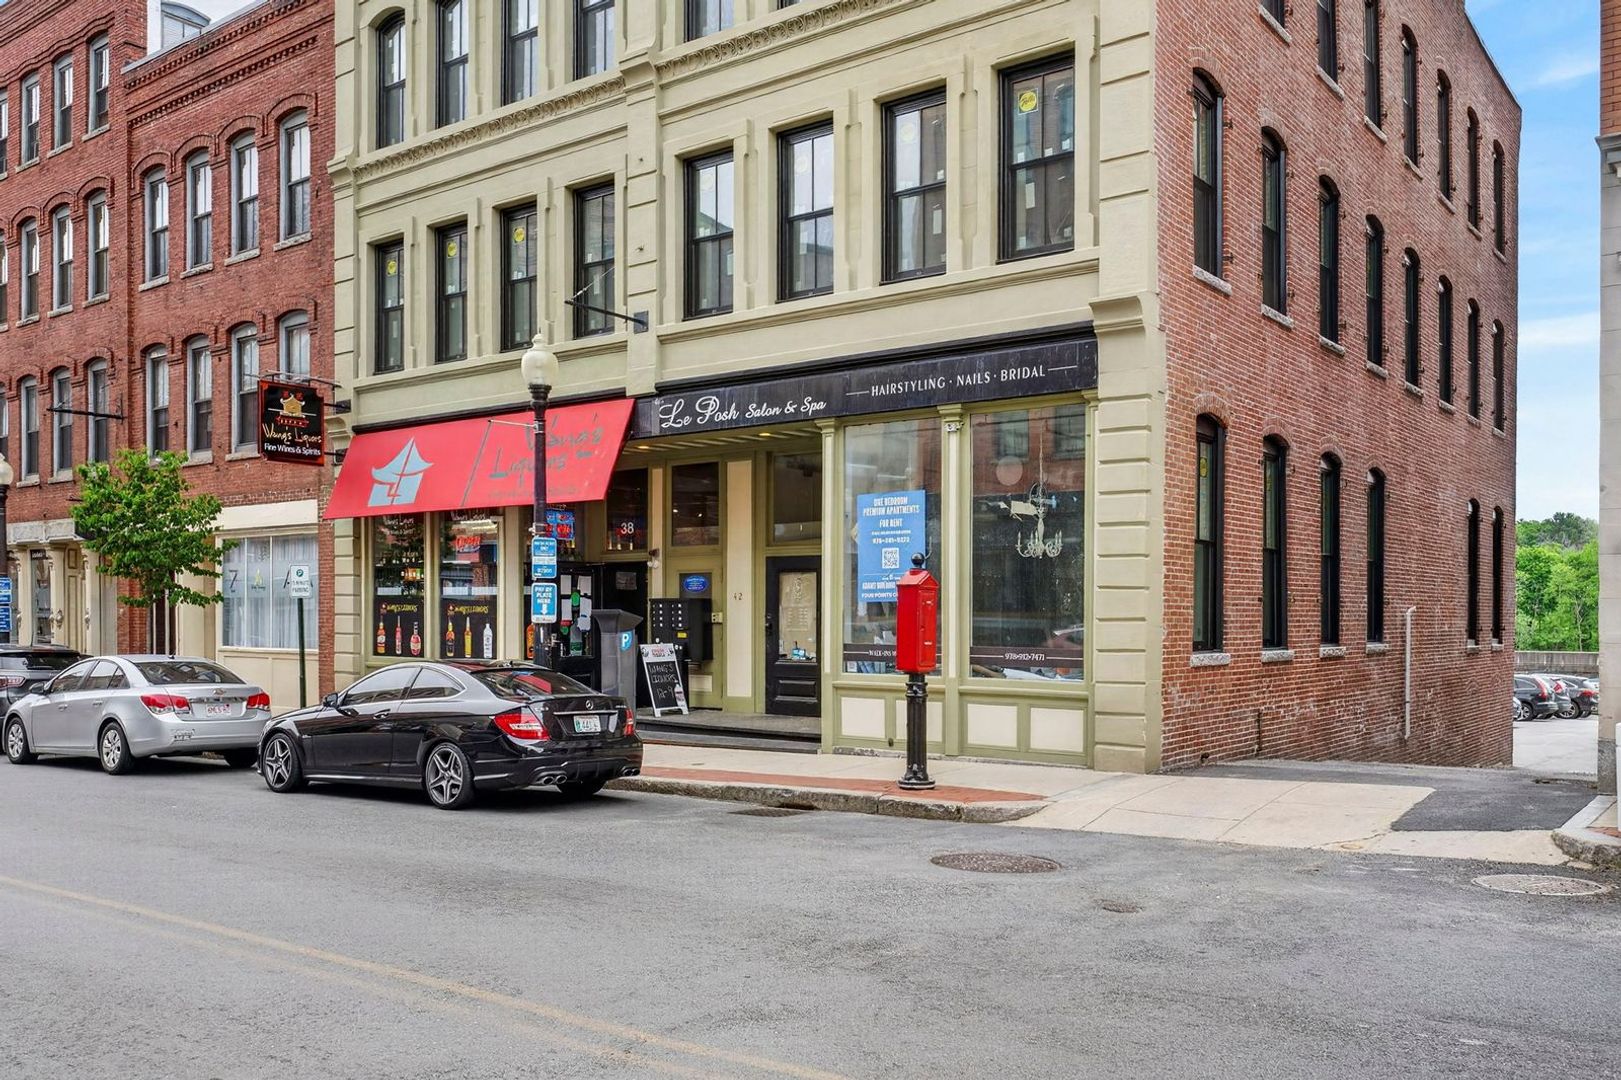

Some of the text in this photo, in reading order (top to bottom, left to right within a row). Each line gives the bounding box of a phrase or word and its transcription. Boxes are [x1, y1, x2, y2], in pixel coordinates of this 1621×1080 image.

[871, 365, 1046, 397] HAIRSTYLING NAILS BRIDAL
[659, 395, 827, 428] Le Posh Salon & Spa
[294, 427, 322, 448] Liquors
[488, 447, 567, 488] Liqurs
[886, 504, 920, 515] APARTMENTS
[621, 522, 634, 535] 38
[880, 518, 903, 528] FOR RENT
